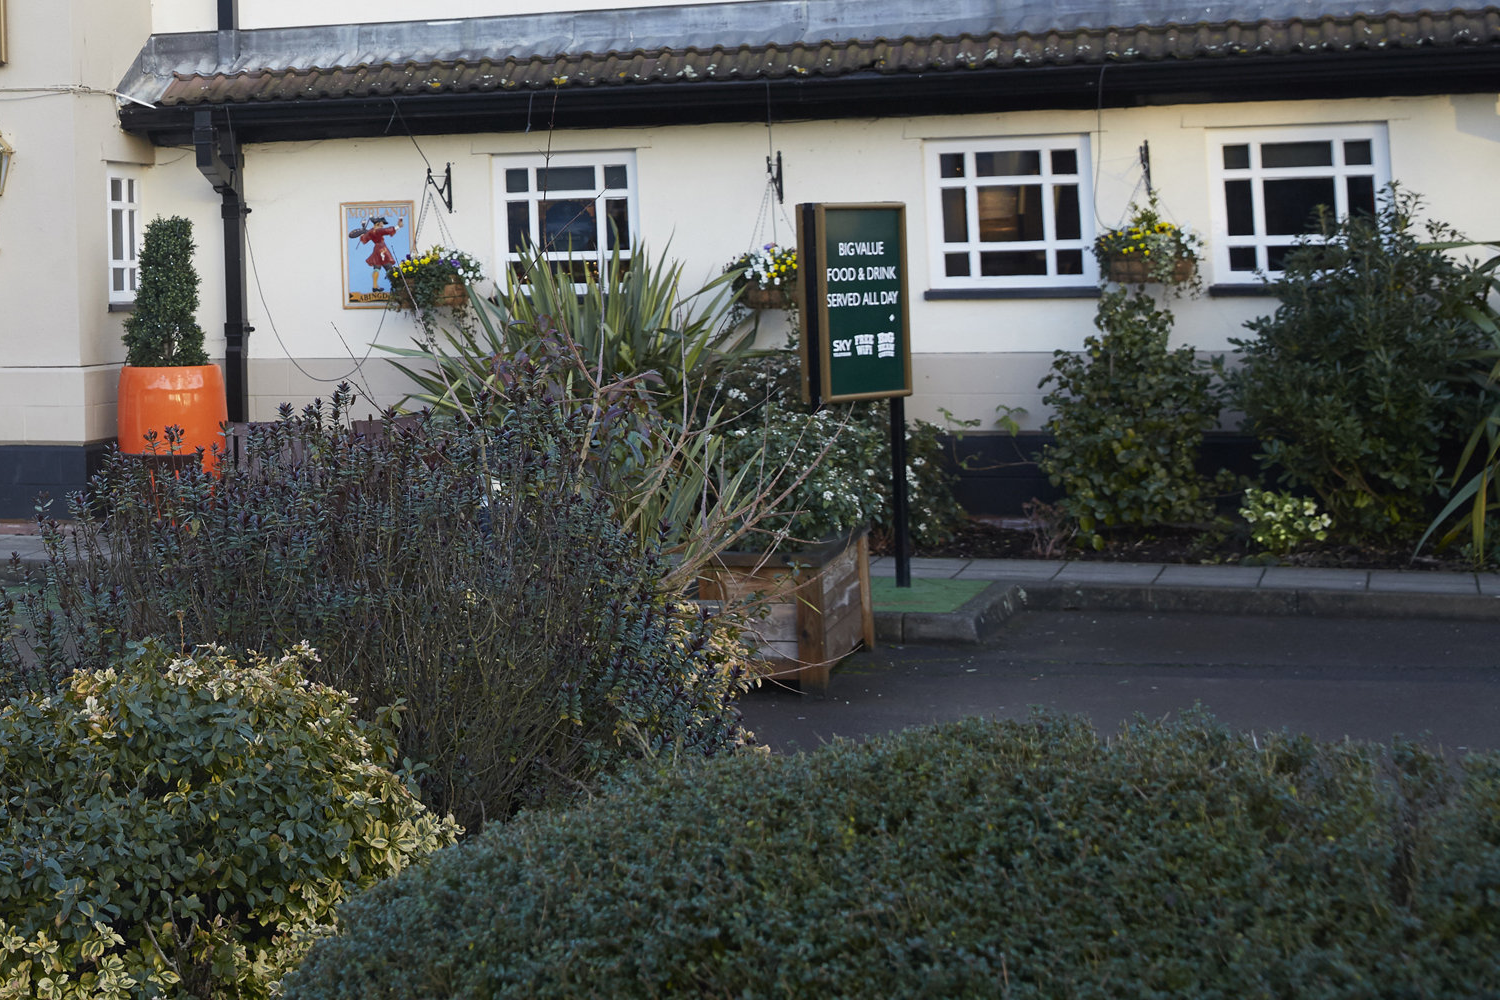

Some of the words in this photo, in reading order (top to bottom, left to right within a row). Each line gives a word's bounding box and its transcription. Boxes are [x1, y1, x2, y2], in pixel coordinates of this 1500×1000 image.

[348, 207, 408, 219] MORLAND
[838, 242, 855, 256] BIG
[854, 241, 884, 255] VALUE
[826, 267, 856, 281] FOOD
[857, 267, 865, 281] &
[866, 266, 896, 280] DRINK
[359, 292, 388, 302] ABINGD
[826, 292, 861, 307] SERVED
[862, 291, 879, 305] ALL
[880, 291, 898, 305] DAY
[833, 339, 852, 352] SKY
